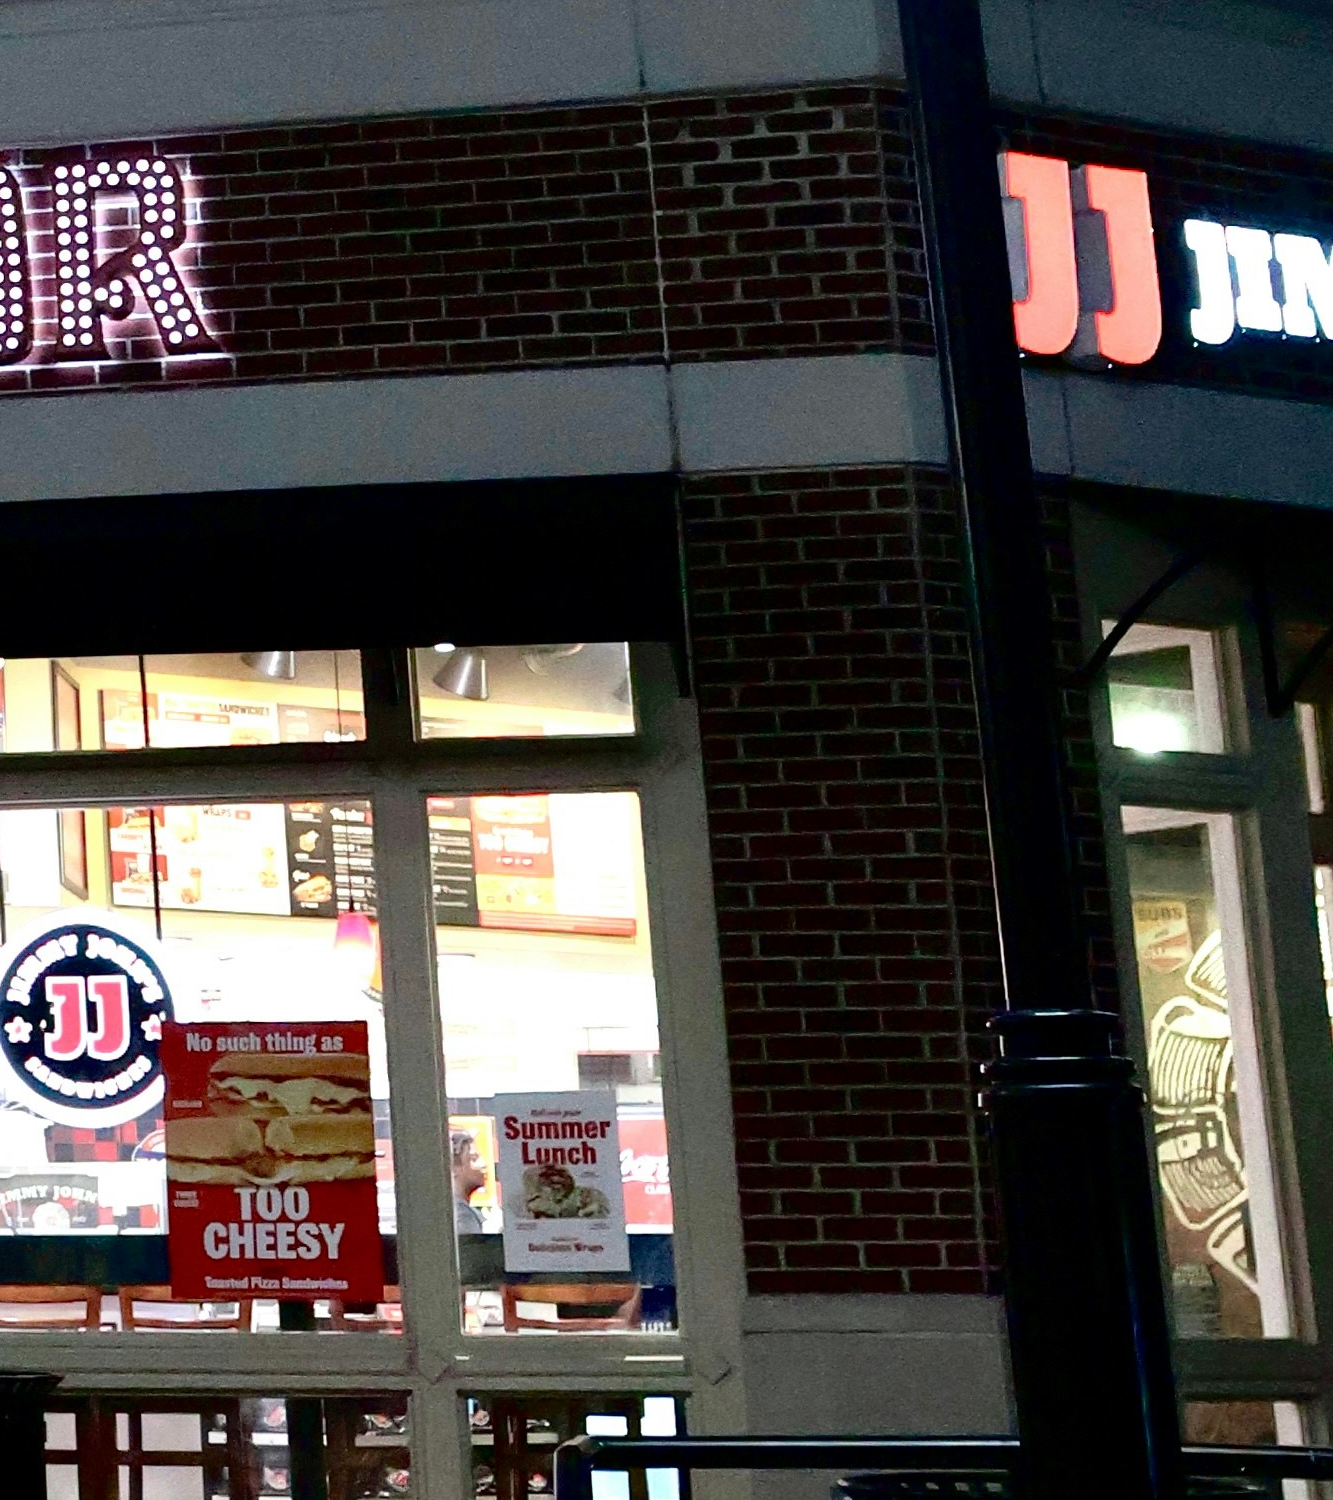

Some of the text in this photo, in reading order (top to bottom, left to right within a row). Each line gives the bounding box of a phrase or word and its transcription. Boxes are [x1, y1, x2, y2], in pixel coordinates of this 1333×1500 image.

[998, 150, 1163, 366] JJ
[6, 933, 78, 1006] JIMMY
[44, 975, 131, 1061] JJ
[186, 1032, 343, 1054] No such thing as
[25, 1055, 152, 1099] SANDWICHES
[503, 1115, 611, 1140] Summer
[521, 1141, 597, 1166] Lunch
[234, 1186, 310, 1221] TOO
[203, 1222, 346, 1261] CHEESY
[204, 1276, 349, 1291] Toasted Pizza Sandwiches
